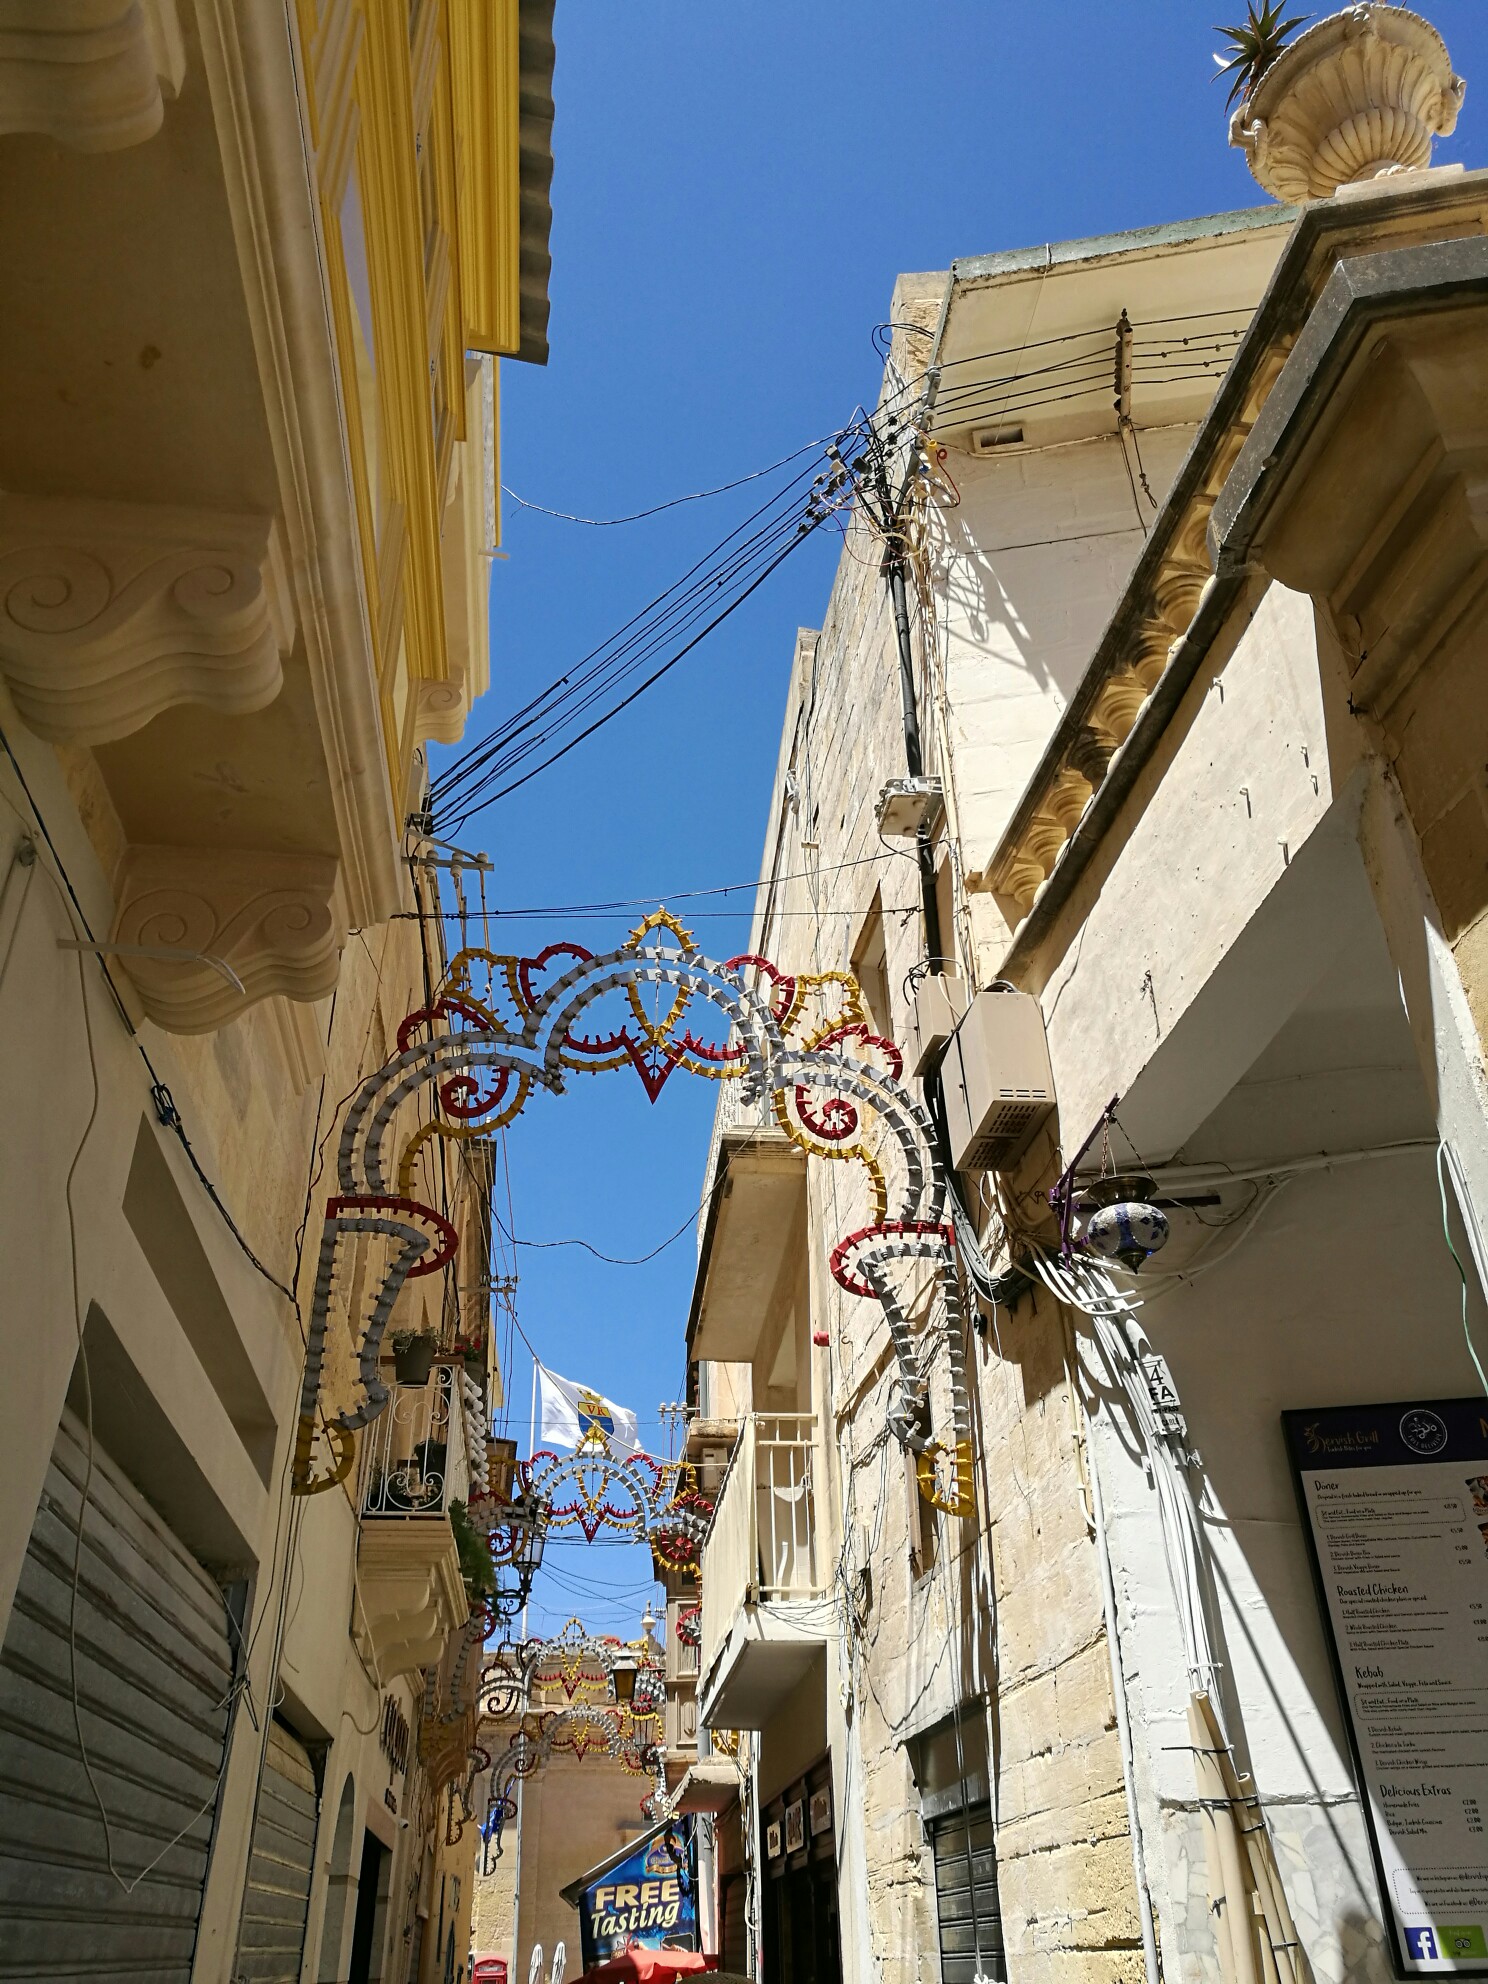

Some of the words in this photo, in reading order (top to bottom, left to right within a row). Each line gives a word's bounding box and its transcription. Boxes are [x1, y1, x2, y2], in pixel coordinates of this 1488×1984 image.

[1150, 1366, 1165, 1385] 4
[1148, 1385, 1175, 1401] FA
[586, 1405, 607, 1416] VR
[1337, 1584, 1371, 1596] Roasted
[1373, 1583, 1408, 1595] Chicken
[1355, 1666, 1384, 1679] Kebab
[1379, 1784, 1420, 1797] Delicious
[1421, 1783, 1452, 1796] Extras
[595, 1878, 680, 1911] FREE
[591, 1901, 681, 1939] Tasting
